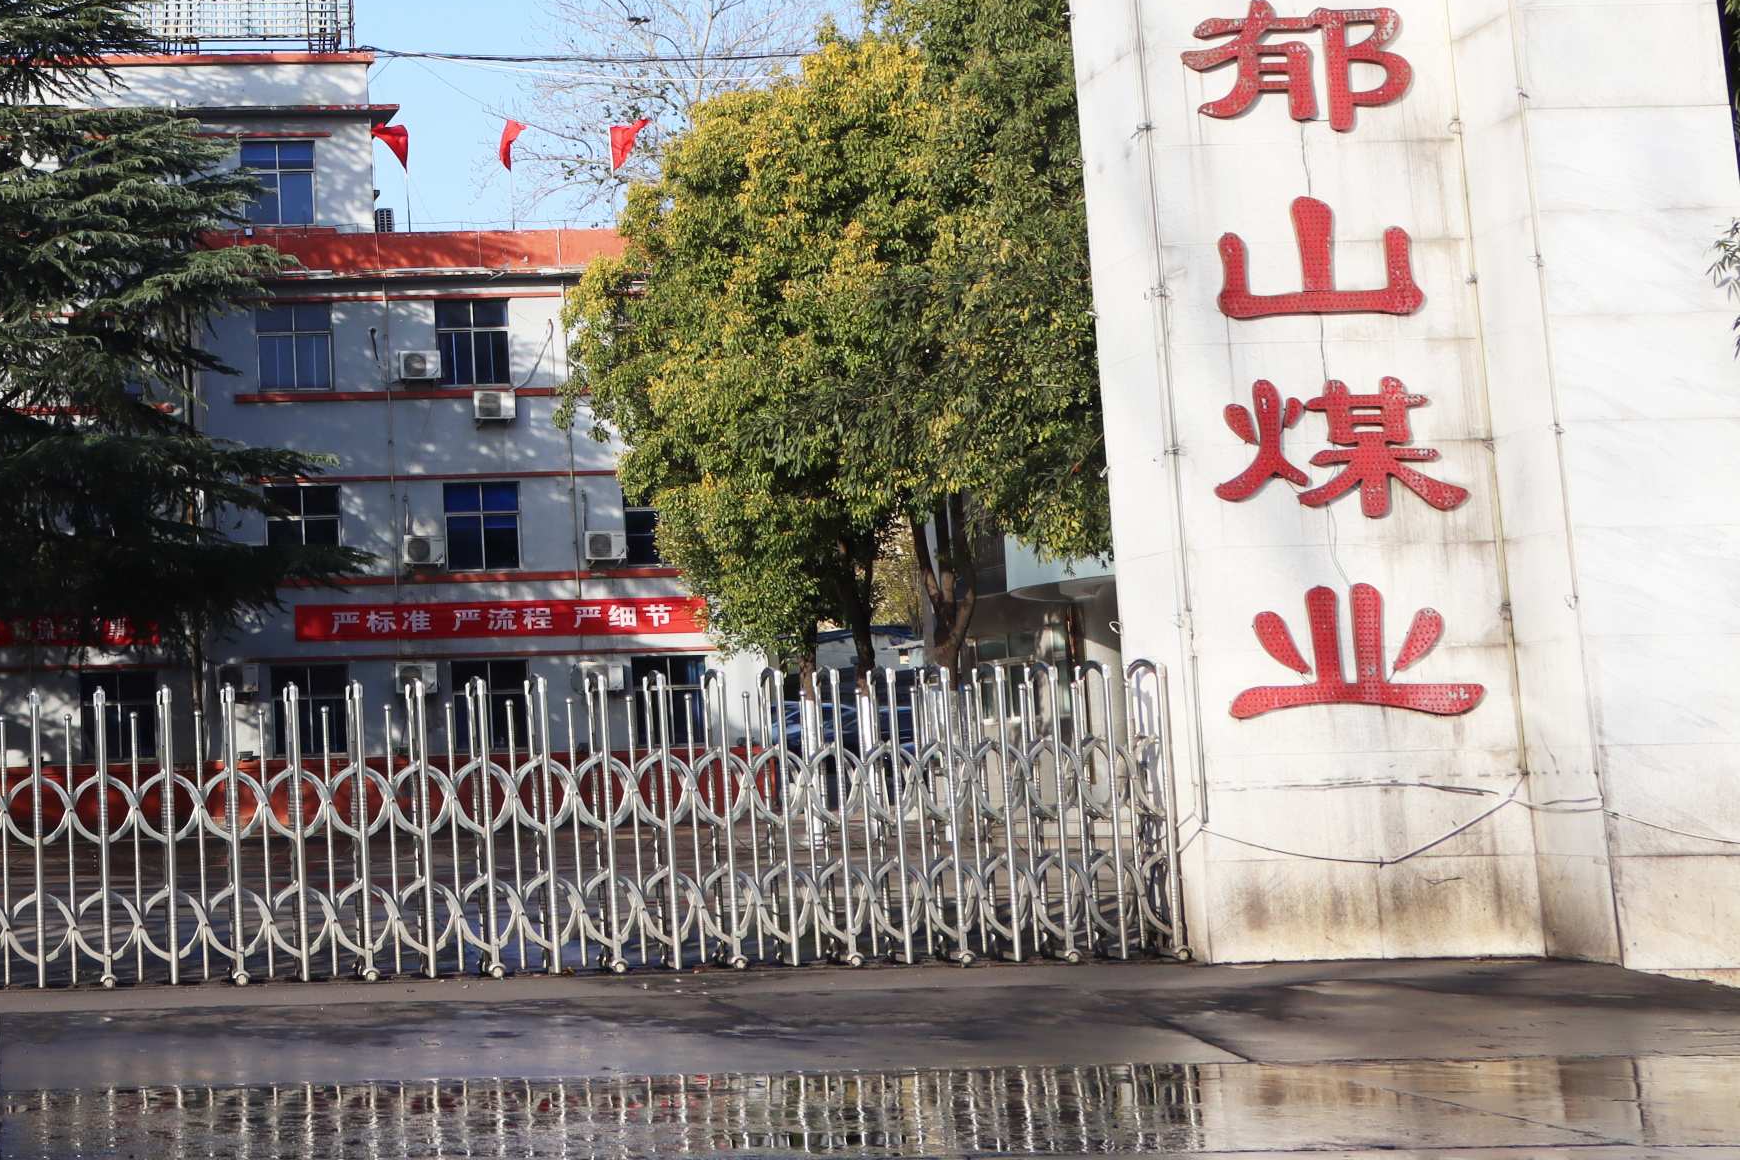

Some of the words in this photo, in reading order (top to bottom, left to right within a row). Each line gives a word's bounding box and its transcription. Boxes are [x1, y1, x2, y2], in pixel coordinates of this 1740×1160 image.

[331, 609, 432, 634] 严标准
[453, 606, 554, 631] 严流程
[573, 603, 673, 628] 严细节
